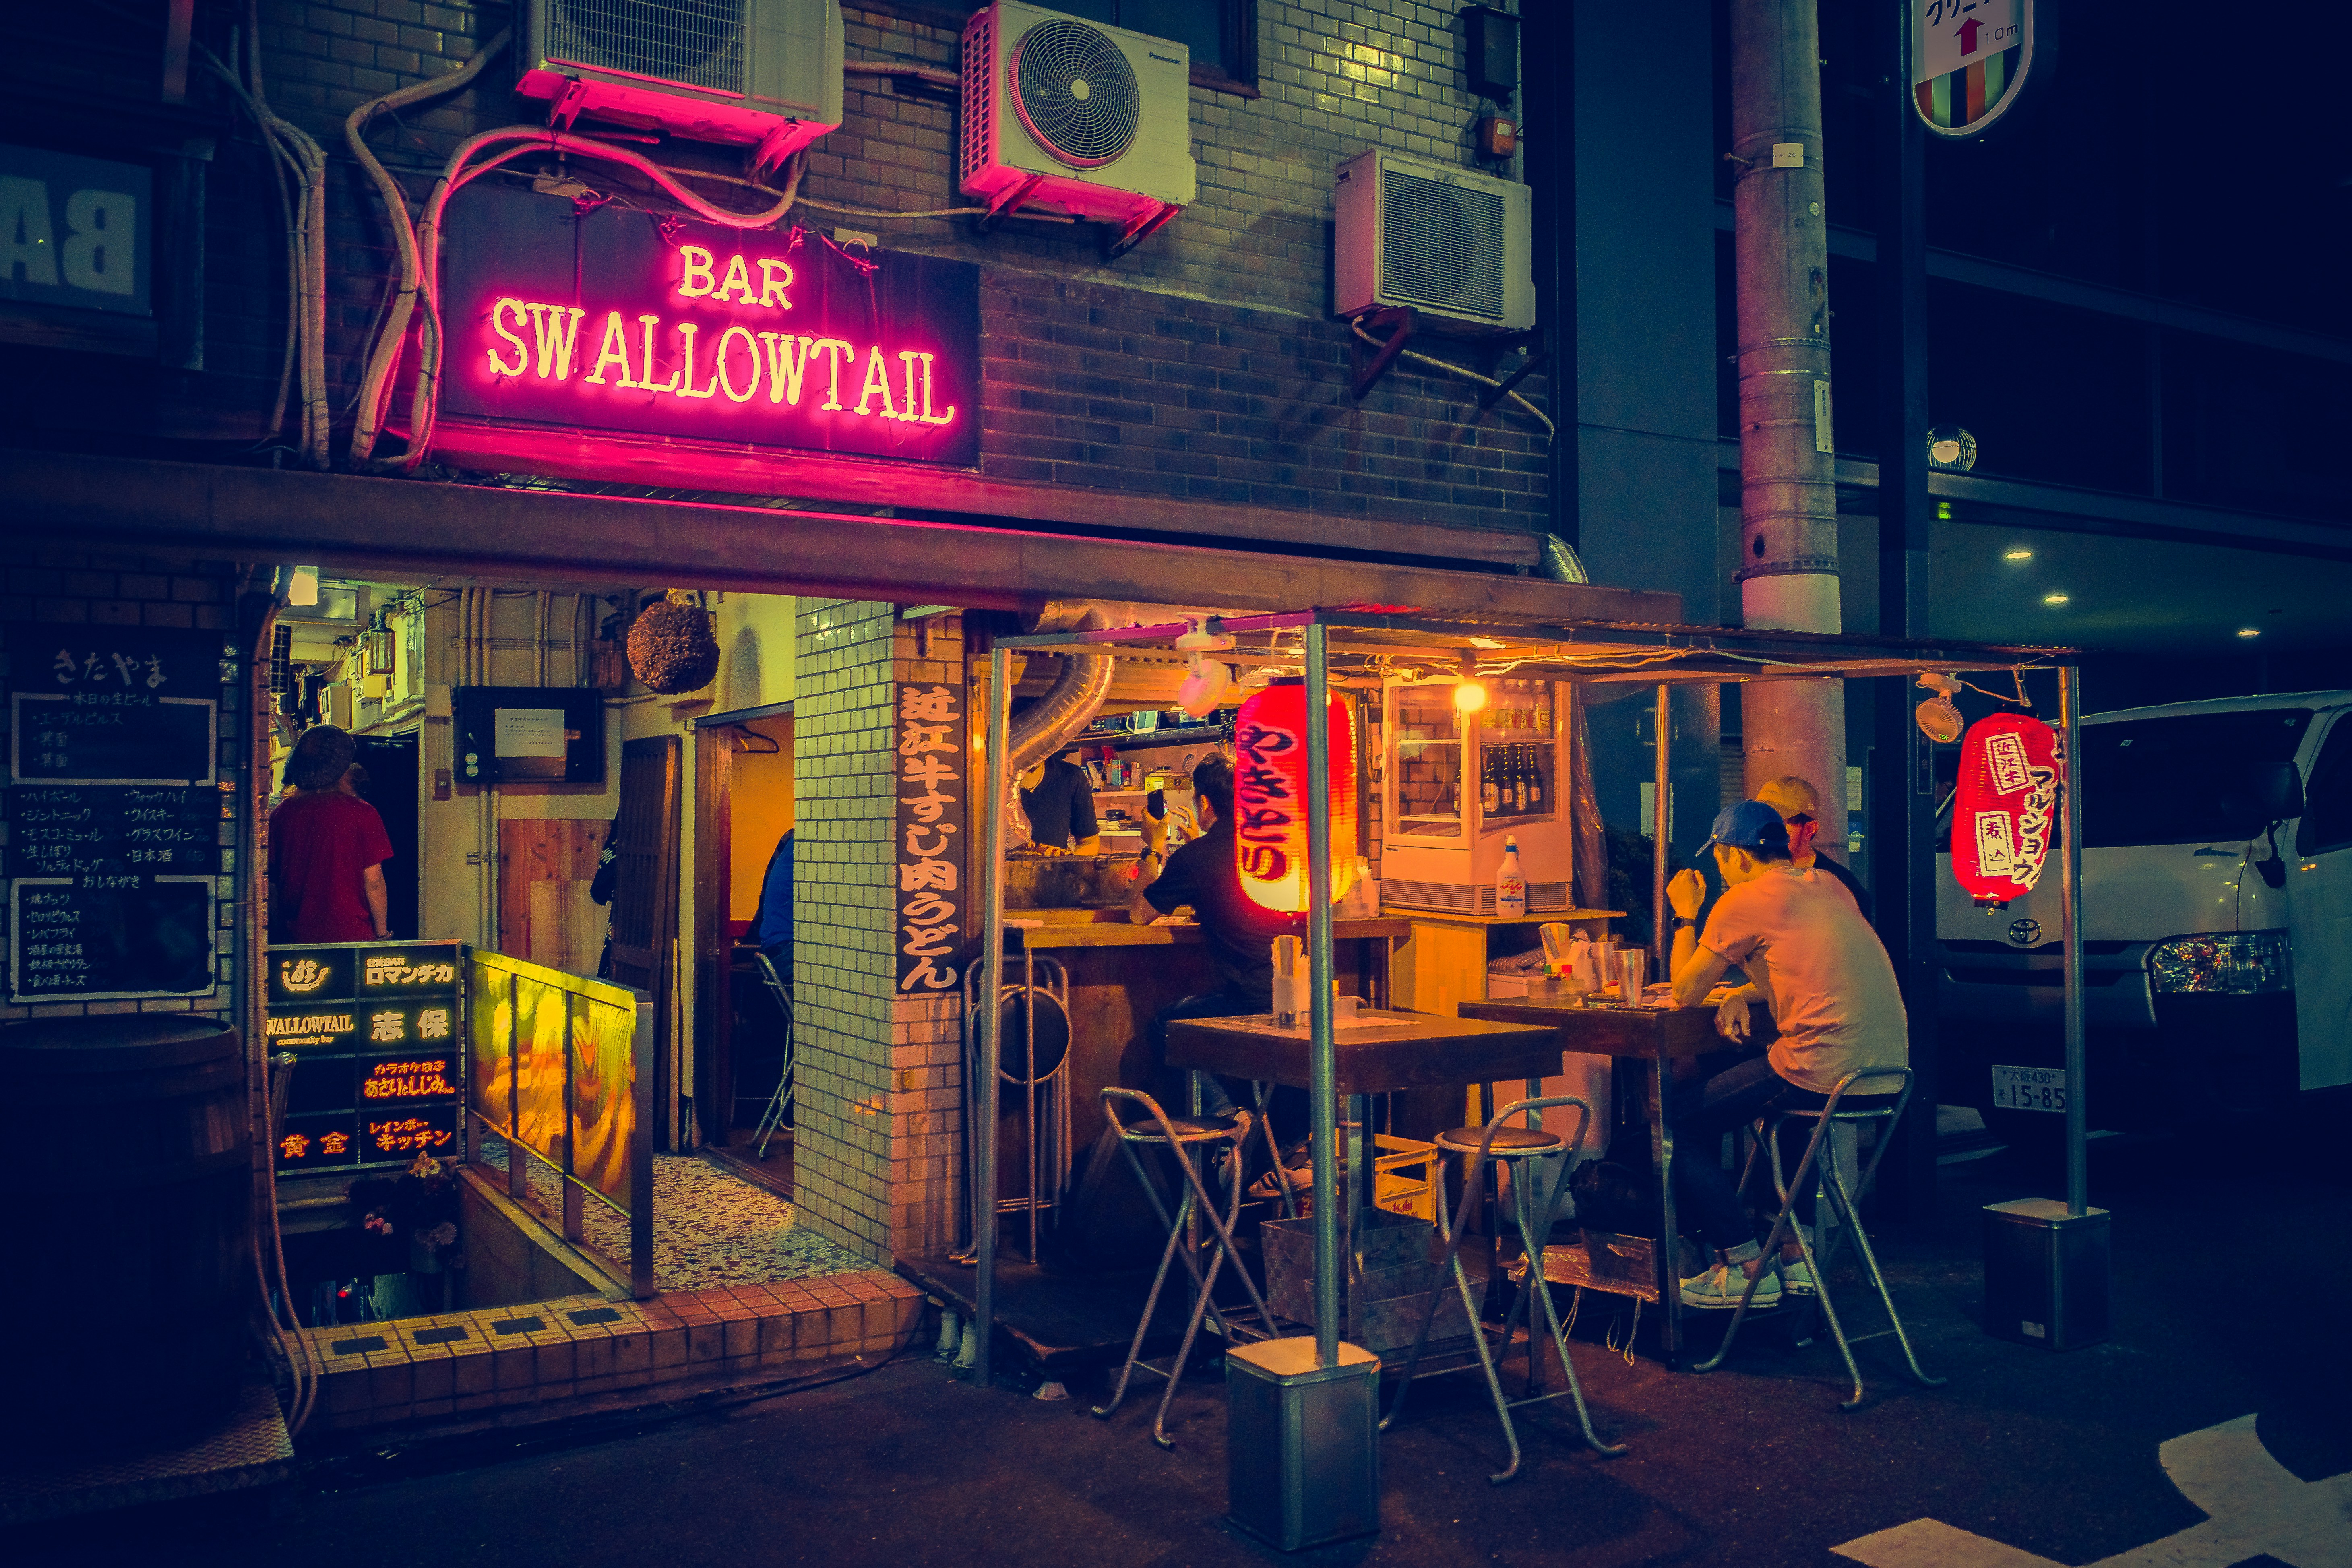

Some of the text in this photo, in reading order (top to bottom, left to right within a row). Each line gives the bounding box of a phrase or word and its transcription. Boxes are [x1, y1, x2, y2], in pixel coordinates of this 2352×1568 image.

[678, 245, 794, 310] BAR
[486, 297, 955, 425] SWALLOWTAIL
[53, 648, 167, 688] きたやま
[73, 690, 152, 707] 本日の生ビール
[1996, 741, 2021, 783] 近江牛
[26, 790, 83, 804] ハイボール
[25, 807, 91, 822] ジントニック
[131, 827, 194, 842] グラスワイン
[1985, 820, 2006, 862] 煮込
[27, 845, 71, 859] 生しぼり
[132, 849, 173, 863] 日本酒
[82, 875, 141, 888] おしながき
[366, 963, 453, 985] ロマンチカ
[266, 1015, 354, 1036] WALLOWTAIL
[372, 1010, 448, 1041] 志保
[320, 1035, 335, 1044] bar
[2012, 1085, 2065, 1109] 15-85
[370, 1119, 428, 1133] レインボー
[281, 1132, 349, 1158] 黄金
[377, 1130, 451, 1151] キッチン
